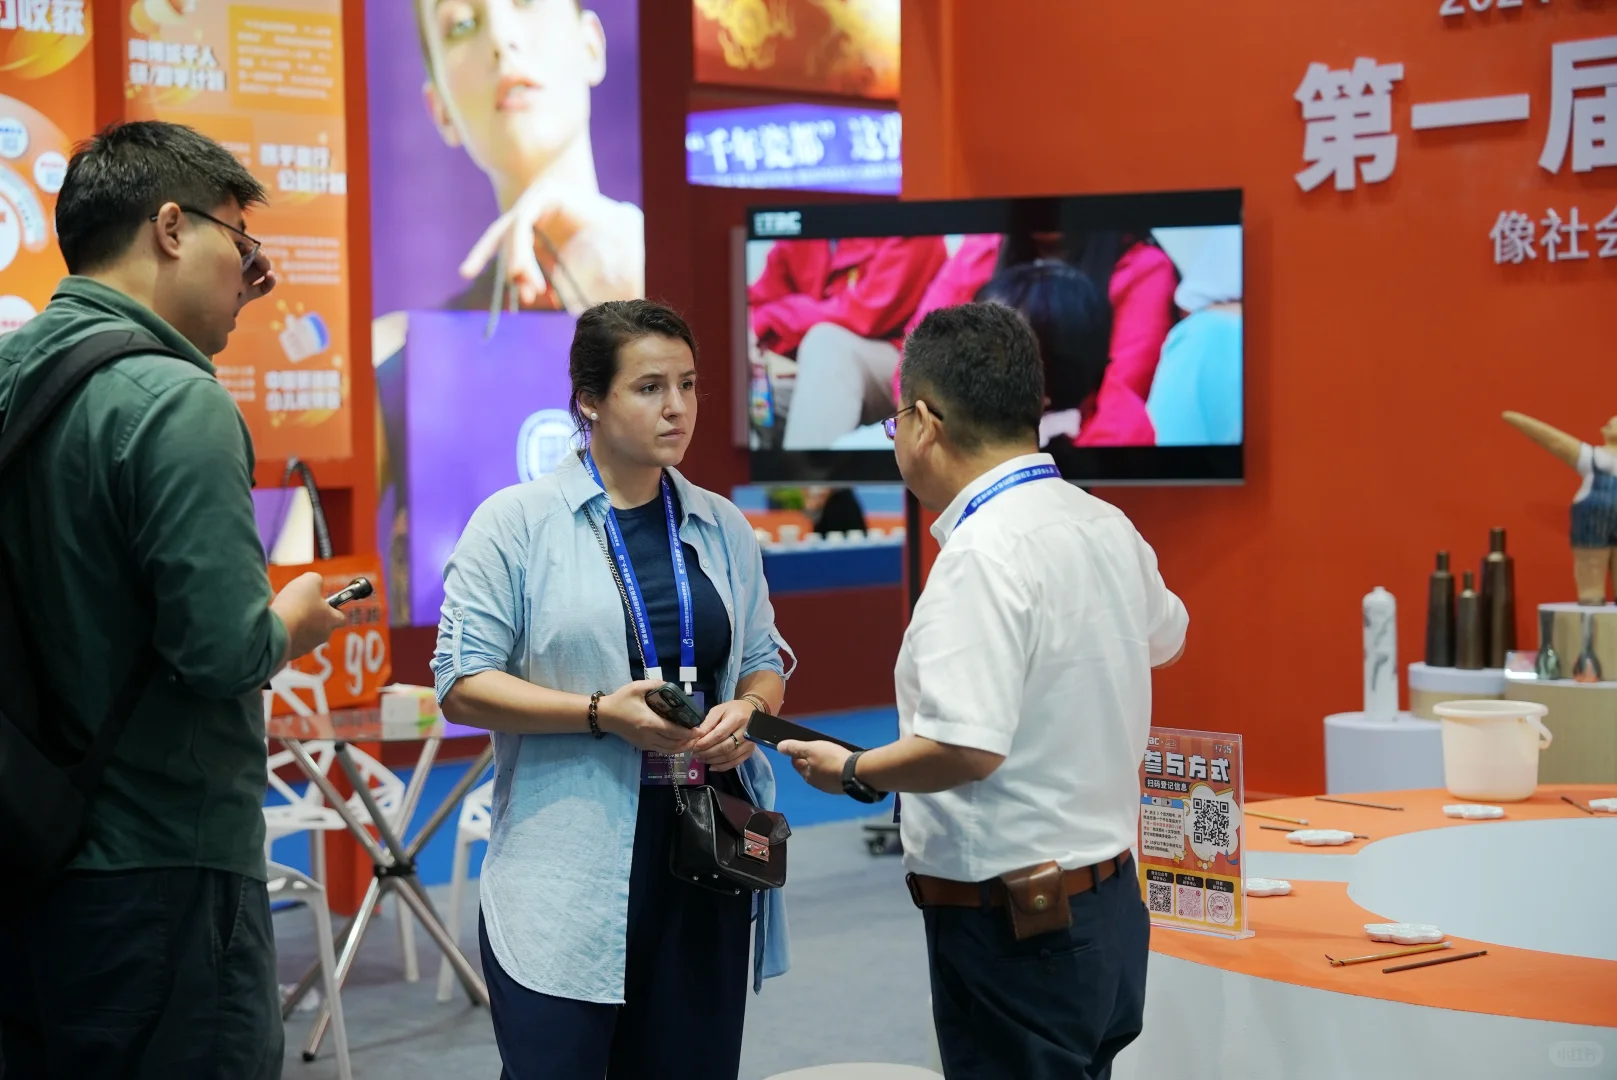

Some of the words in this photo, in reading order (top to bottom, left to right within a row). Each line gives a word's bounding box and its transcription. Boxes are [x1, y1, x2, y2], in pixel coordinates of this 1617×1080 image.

[1294, 36, 1617, 192] 第一届
[345, 629, 385, 697] go
[1145, 749, 1230, 783] 参与方式
[1147, 778, 1188, 792] 扫码登记信息
